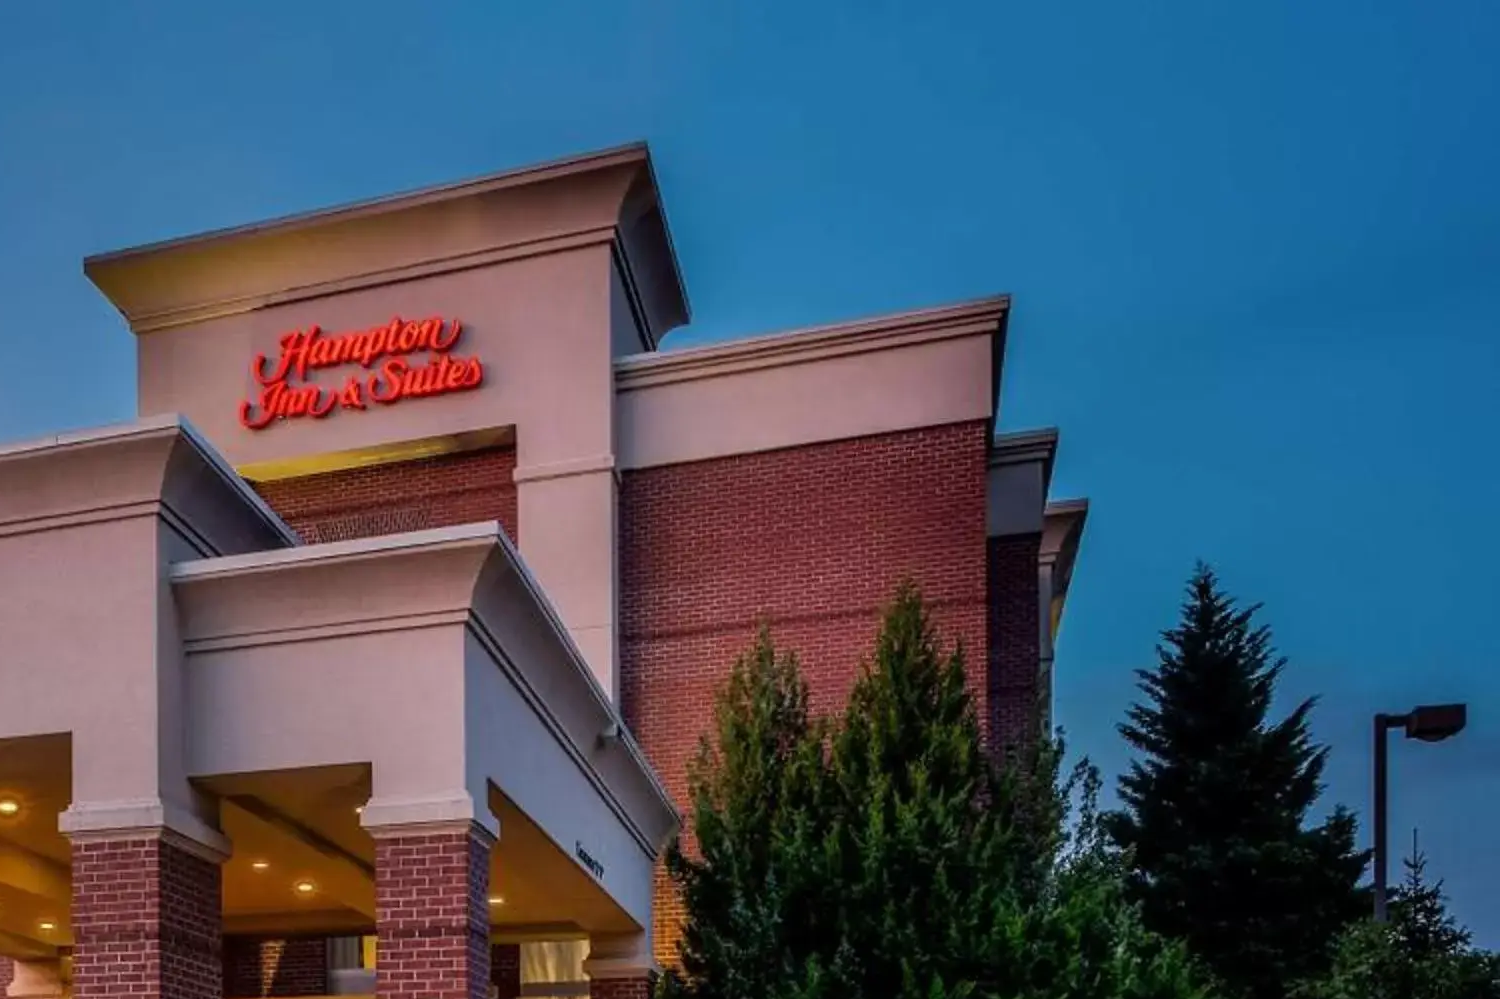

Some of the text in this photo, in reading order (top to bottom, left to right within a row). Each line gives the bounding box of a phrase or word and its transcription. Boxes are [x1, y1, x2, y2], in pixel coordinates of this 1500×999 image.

[254, 316, 461, 383] Hampton
[240, 355, 483, 429] Inn & Suites
